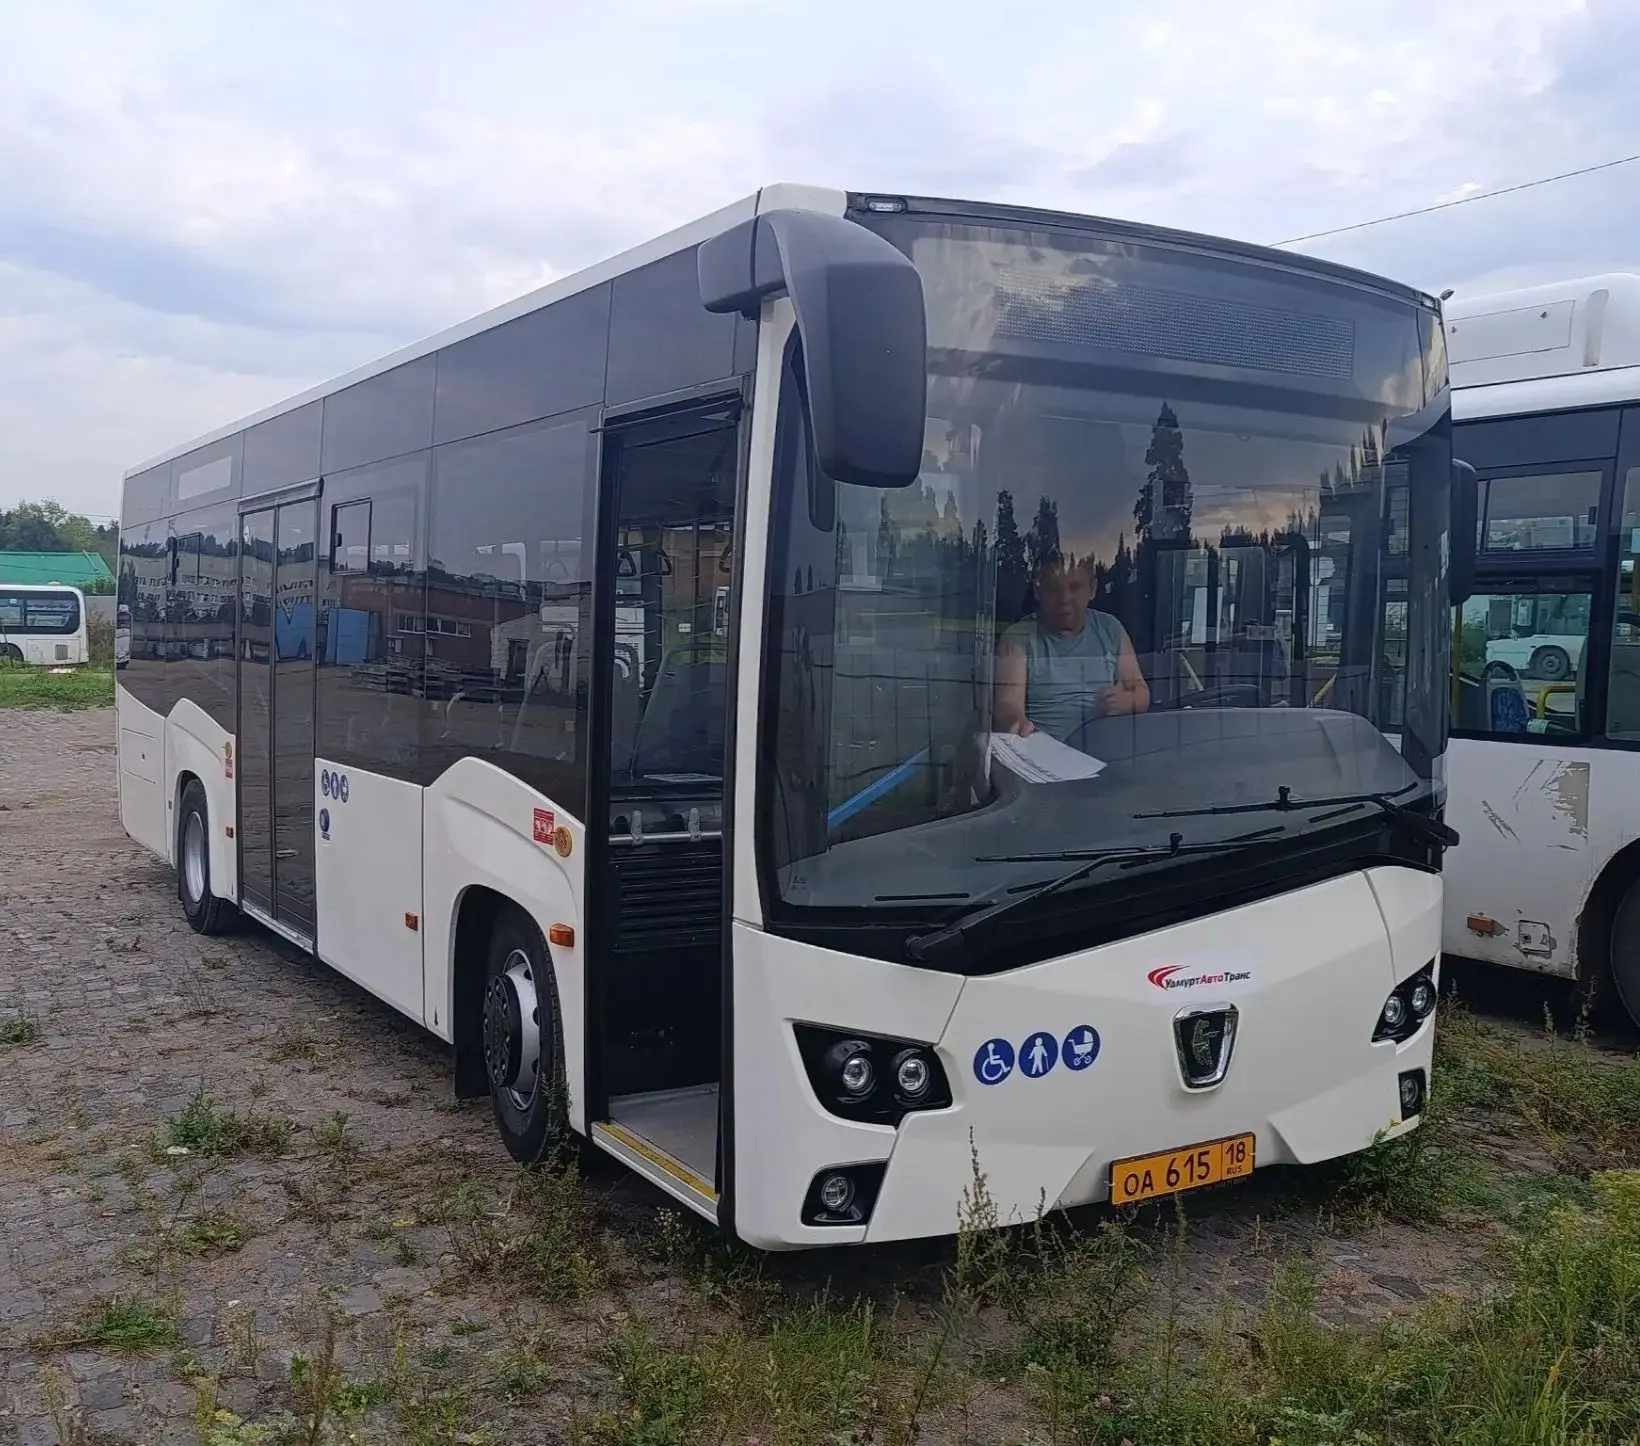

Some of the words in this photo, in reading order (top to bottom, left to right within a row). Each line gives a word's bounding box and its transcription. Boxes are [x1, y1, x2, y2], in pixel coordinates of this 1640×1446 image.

[1165, 971, 1251, 989] УдмуртАвтоТранс
[1166, 1150, 1211, 1188] 615
[1225, 1141, 1246, 1165] 18
[1226, 1166, 1243, 1177] RUS
